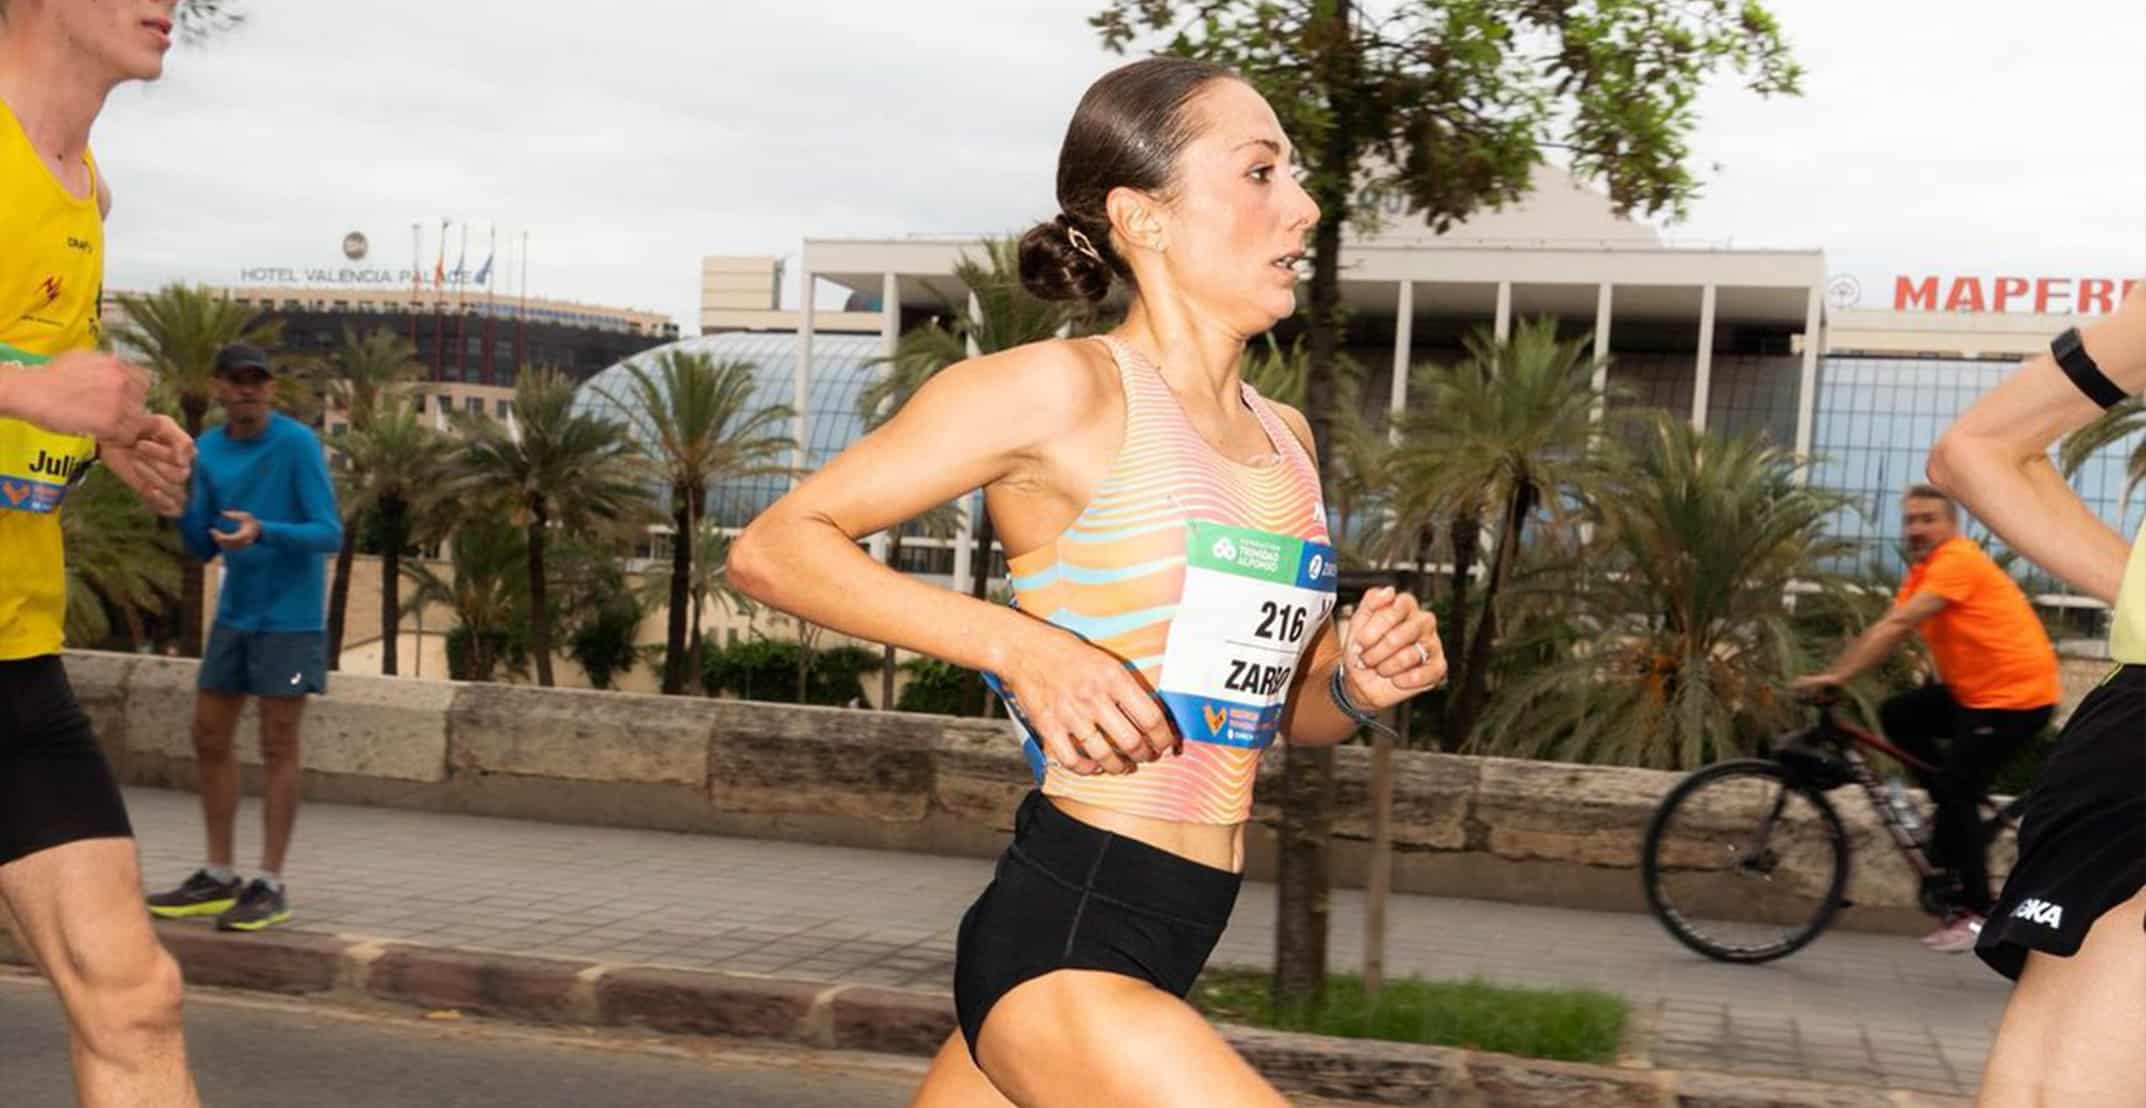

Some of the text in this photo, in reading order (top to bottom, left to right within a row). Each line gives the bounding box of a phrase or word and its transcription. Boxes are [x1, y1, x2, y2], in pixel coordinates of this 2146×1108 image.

[241, 267, 300, 282] HOTEL
[305, 268, 393, 283] VALENCIA
[1254, 600, 1307, 643] 216
